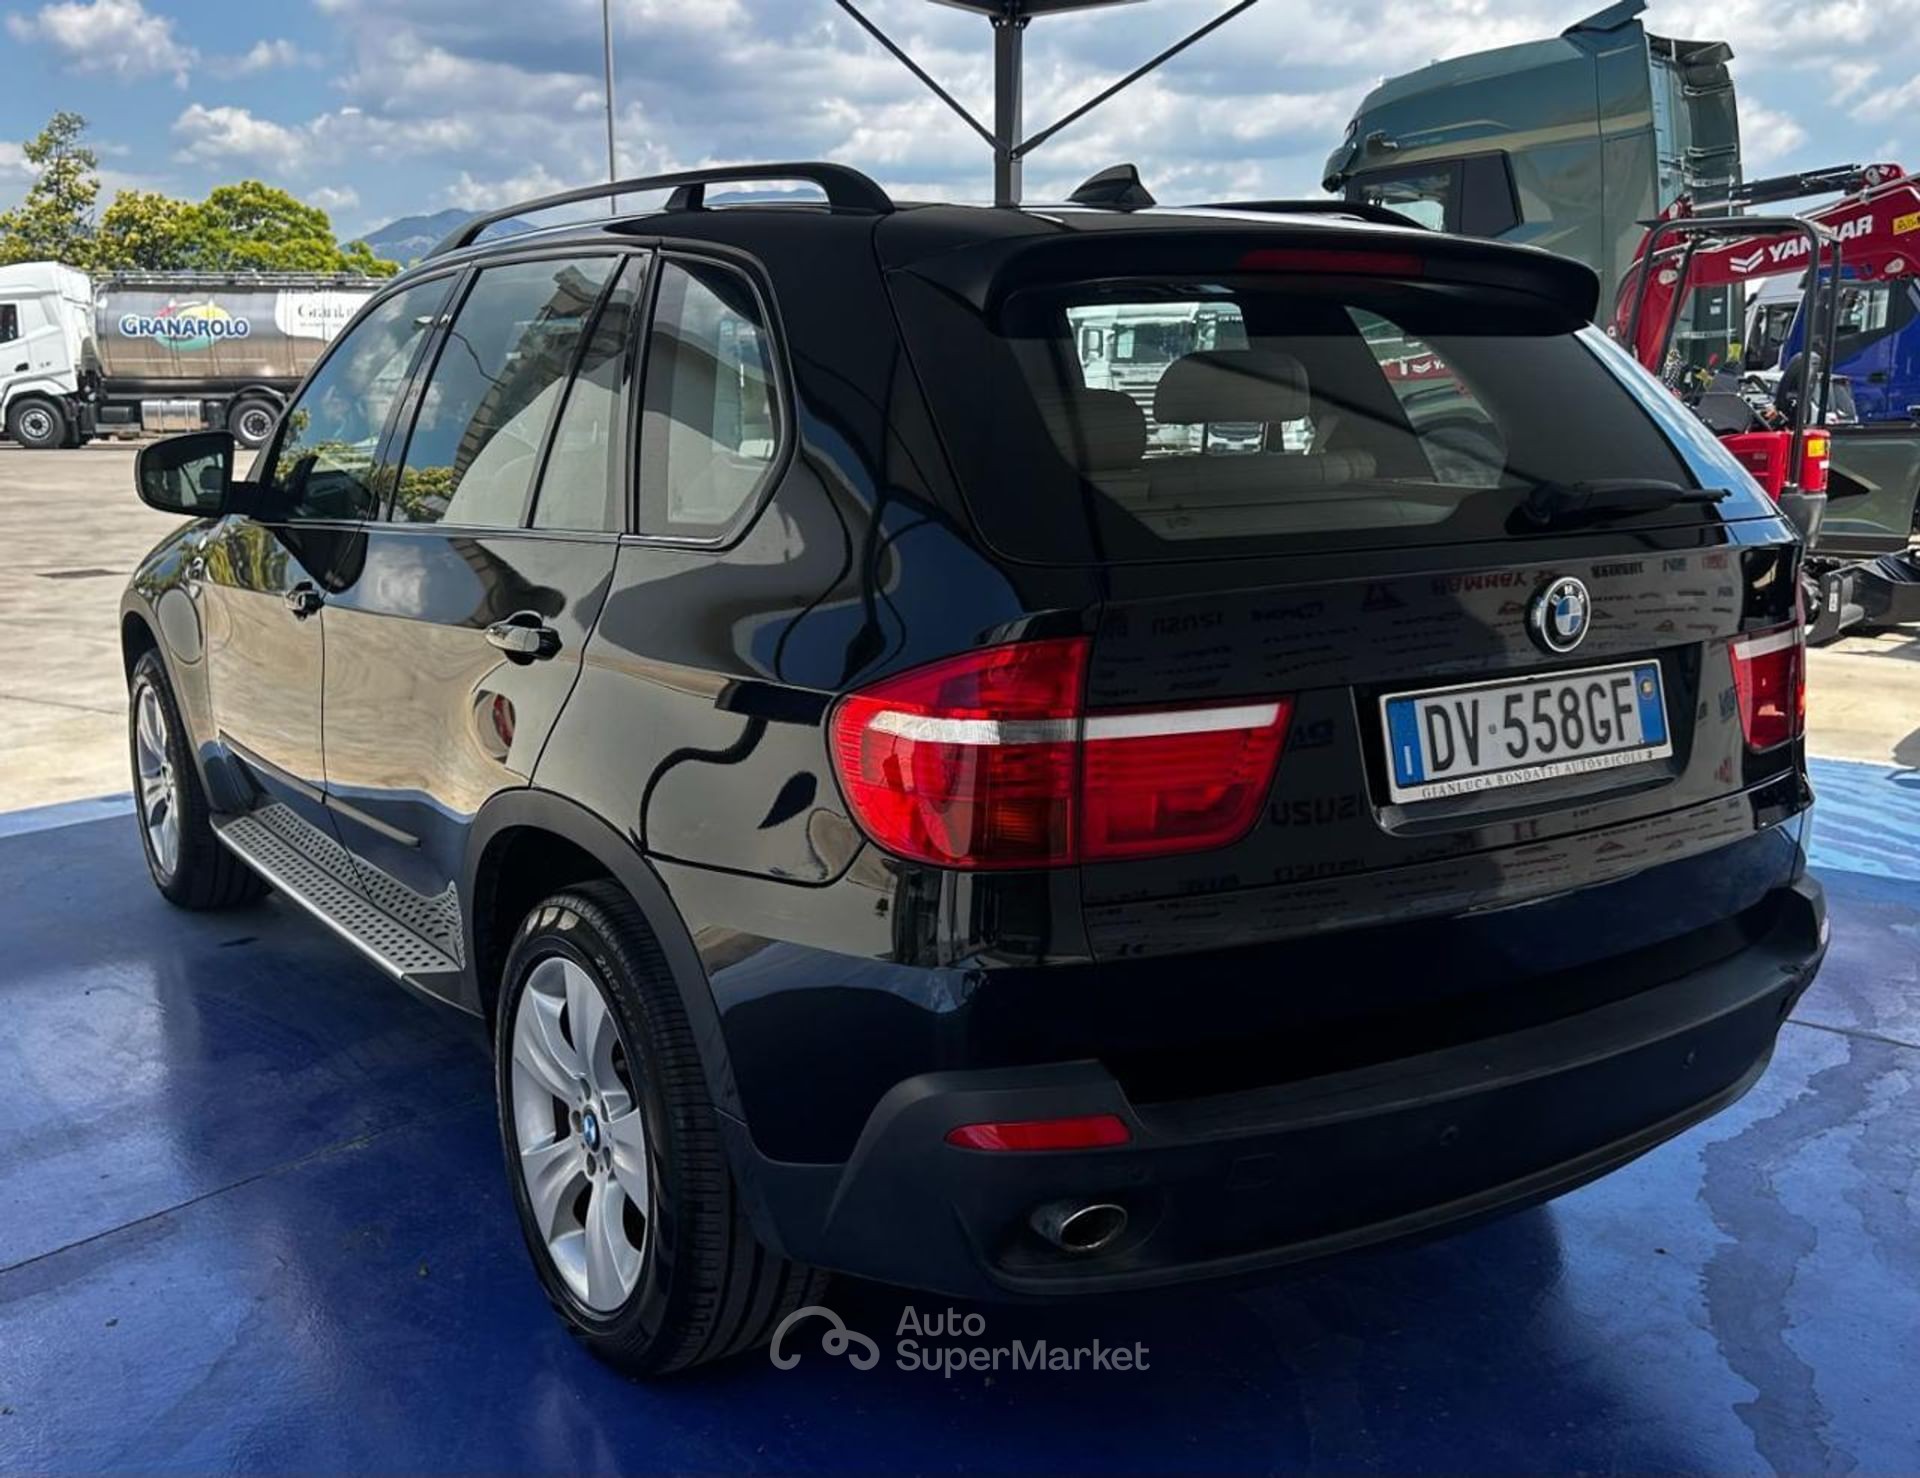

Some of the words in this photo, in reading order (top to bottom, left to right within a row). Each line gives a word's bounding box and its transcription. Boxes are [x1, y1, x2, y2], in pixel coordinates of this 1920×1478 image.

[119, 315, 250, 337] GRANAROLO
[1424, 698, 1479, 772] DV
[1503, 677, 1633, 759] 558GF
[1422, 778, 1492, 799] GIANLUCA
